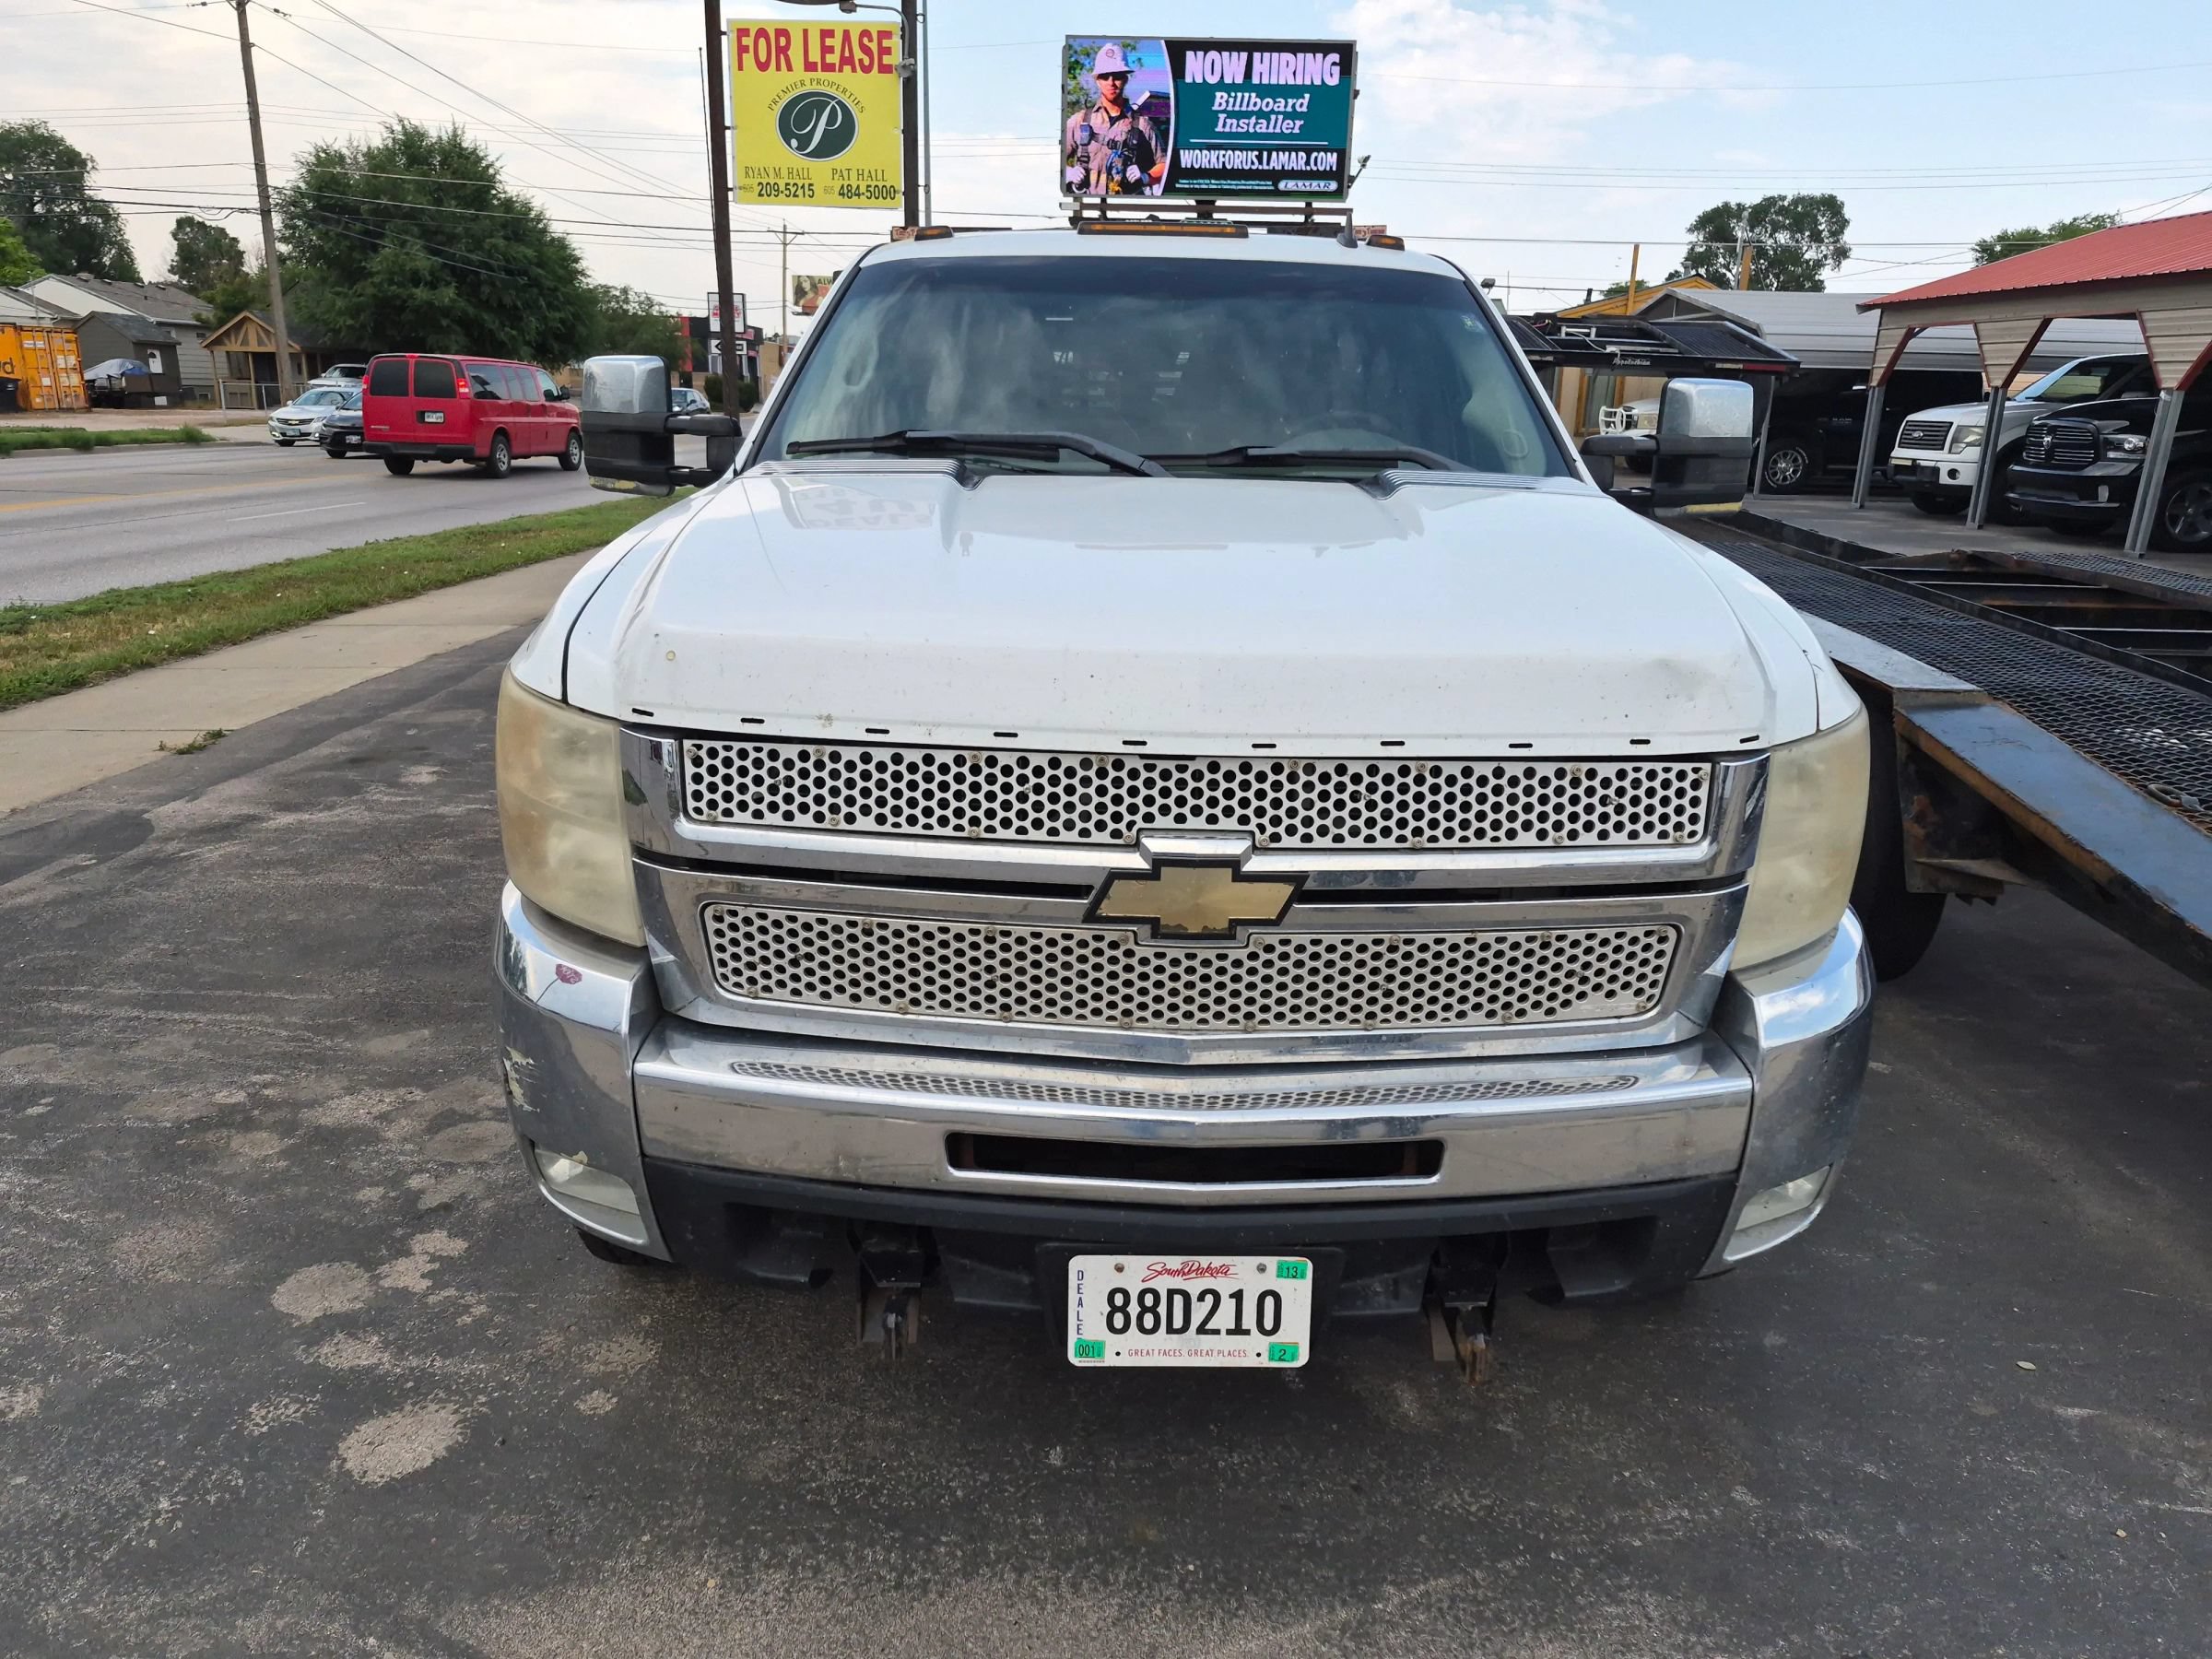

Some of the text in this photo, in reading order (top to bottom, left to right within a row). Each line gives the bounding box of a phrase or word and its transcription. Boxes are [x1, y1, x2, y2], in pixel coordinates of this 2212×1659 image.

[735, 28, 894, 74] FOR LEASE
[1184, 51, 1340, 86] NOW HIRING
[767, 77, 866, 113] PREMIER PROPERTIES
[1212, 91, 1310, 112] Billboard
[1215, 113, 1304, 134] Installer
[1180, 149, 1337, 172] WORKFORUS.LAMAR.COM
[744, 166, 812, 181] RYAN M. HALL
[831, 169, 888, 182] PAT HALL
[758, 182, 815, 198] 209-5215
[838, 183, 897, 201] 484-5000
[1283, 182, 1332, 190] LAMAR
[1141, 1260, 1239, 1282] South Dakota
[1286, 1265, 1299, 1278] 13
[1105, 1287, 1283, 1336] 88D210
[1128, 1348, 1156, 1357] GREAT
[1187, 1348, 1215, 1358] GREAT
[1277, 1348, 1287, 1360] 2
